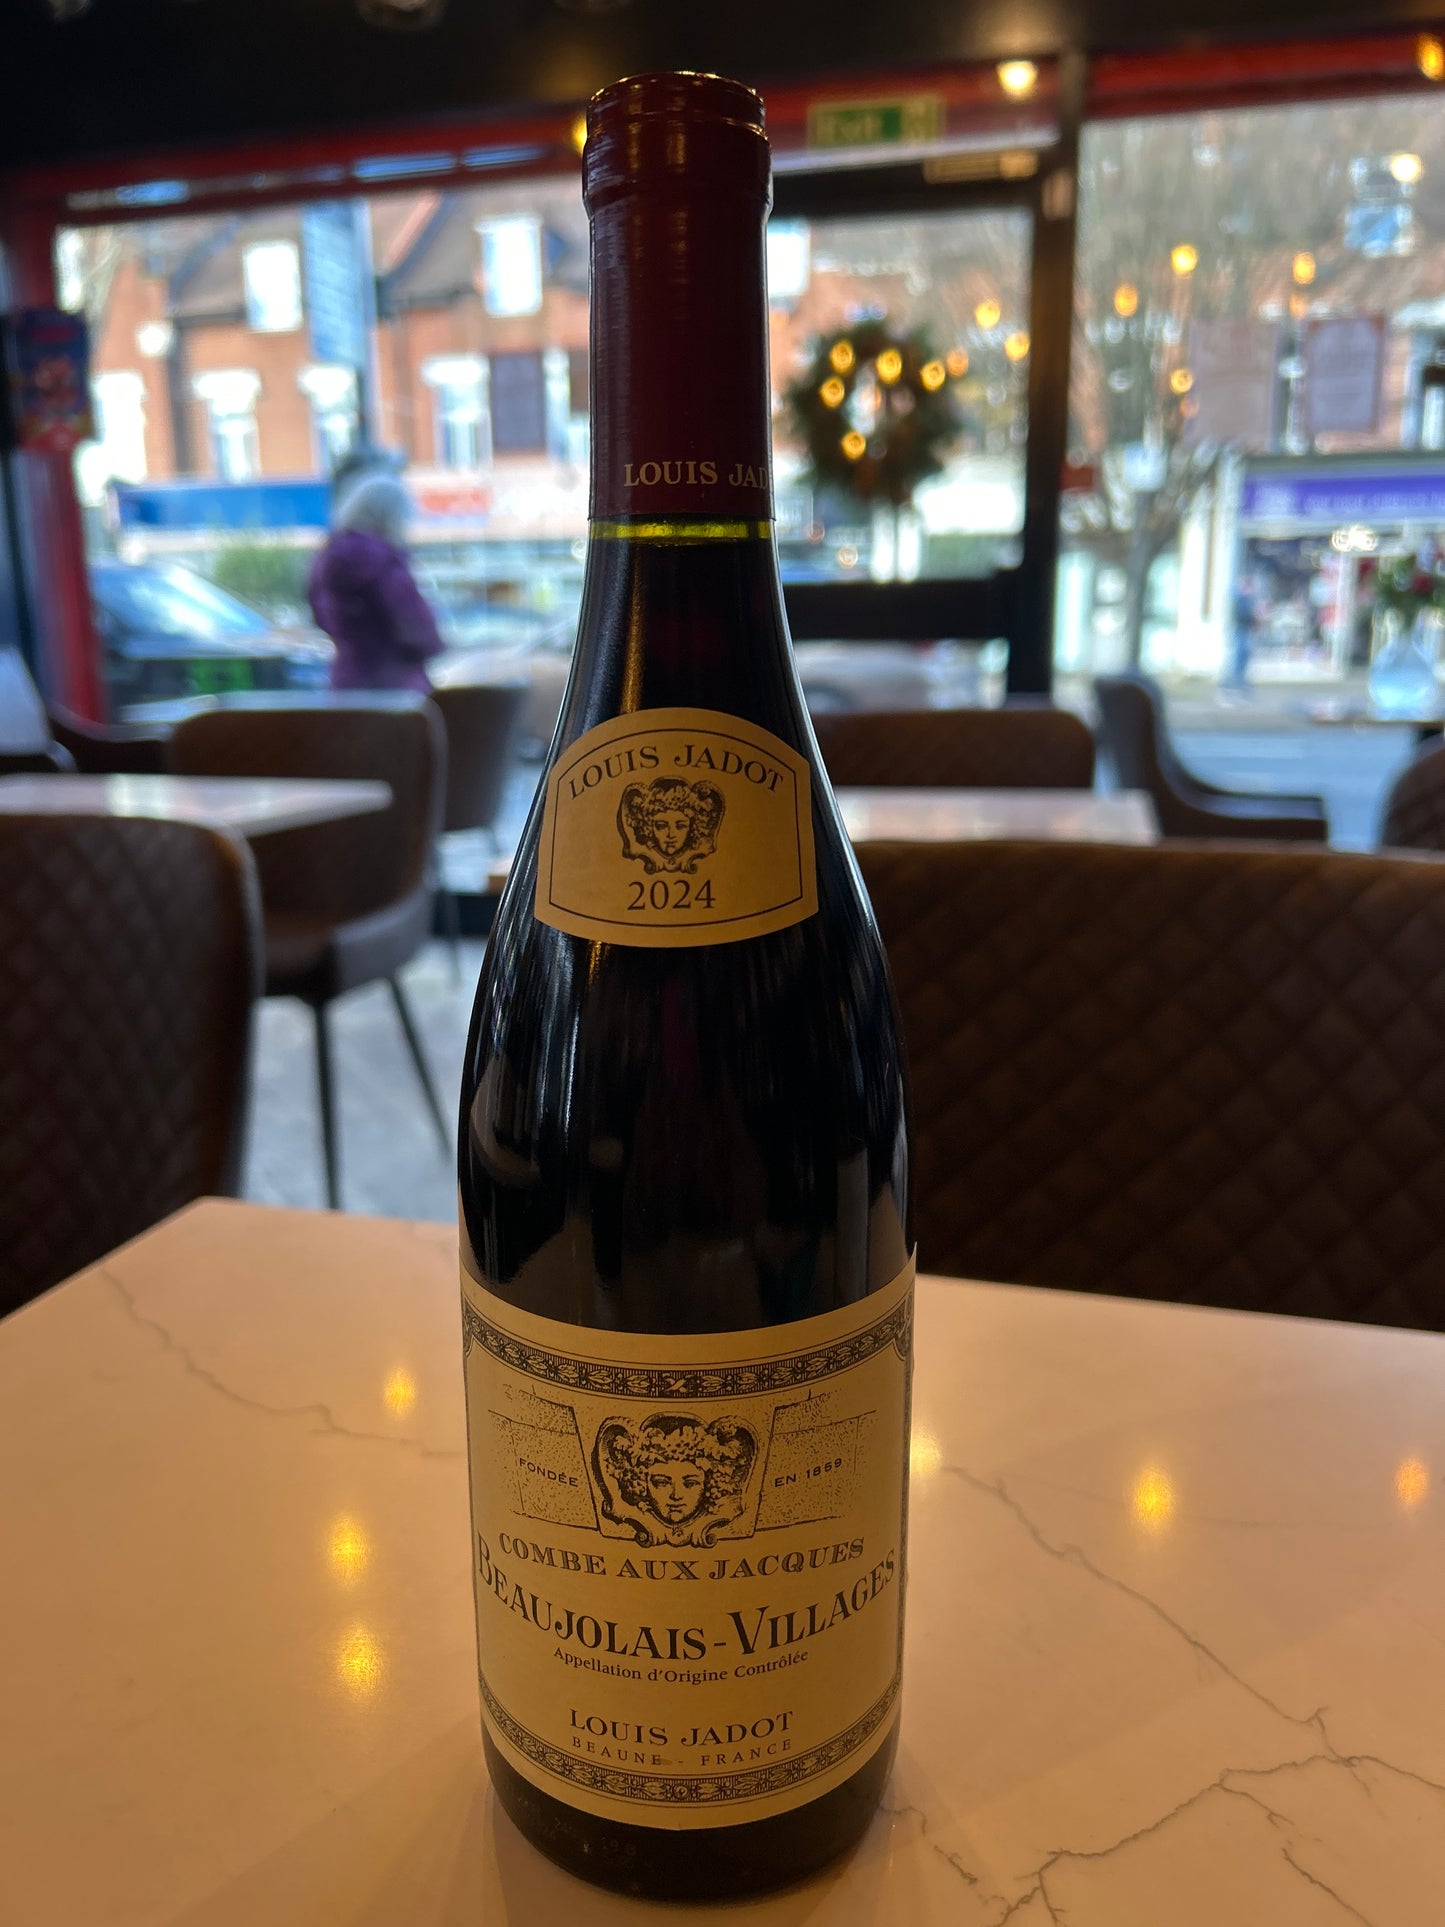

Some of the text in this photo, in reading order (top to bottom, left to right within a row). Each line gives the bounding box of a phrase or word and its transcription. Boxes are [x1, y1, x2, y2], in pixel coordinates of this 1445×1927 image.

[624, 461, 718, 487] LOUIS
[568, 744, 784, 799] LOUIS JADOT
[627, 879, 716, 911] 2024
[519, 1457, 579, 1487] FONDÉE
[774, 1473, 797, 1488] EN
[499, 1532, 865, 1581] COMBE AUX JACQUES
[553, 1647, 809, 1686] Appellation d'Origine Contrôlée
[569, 1708, 793, 1747] LOUIS JADOT
[572, 1736, 662, 1766] BEAUNE
[701, 1738, 792, 1767] FRANCE
